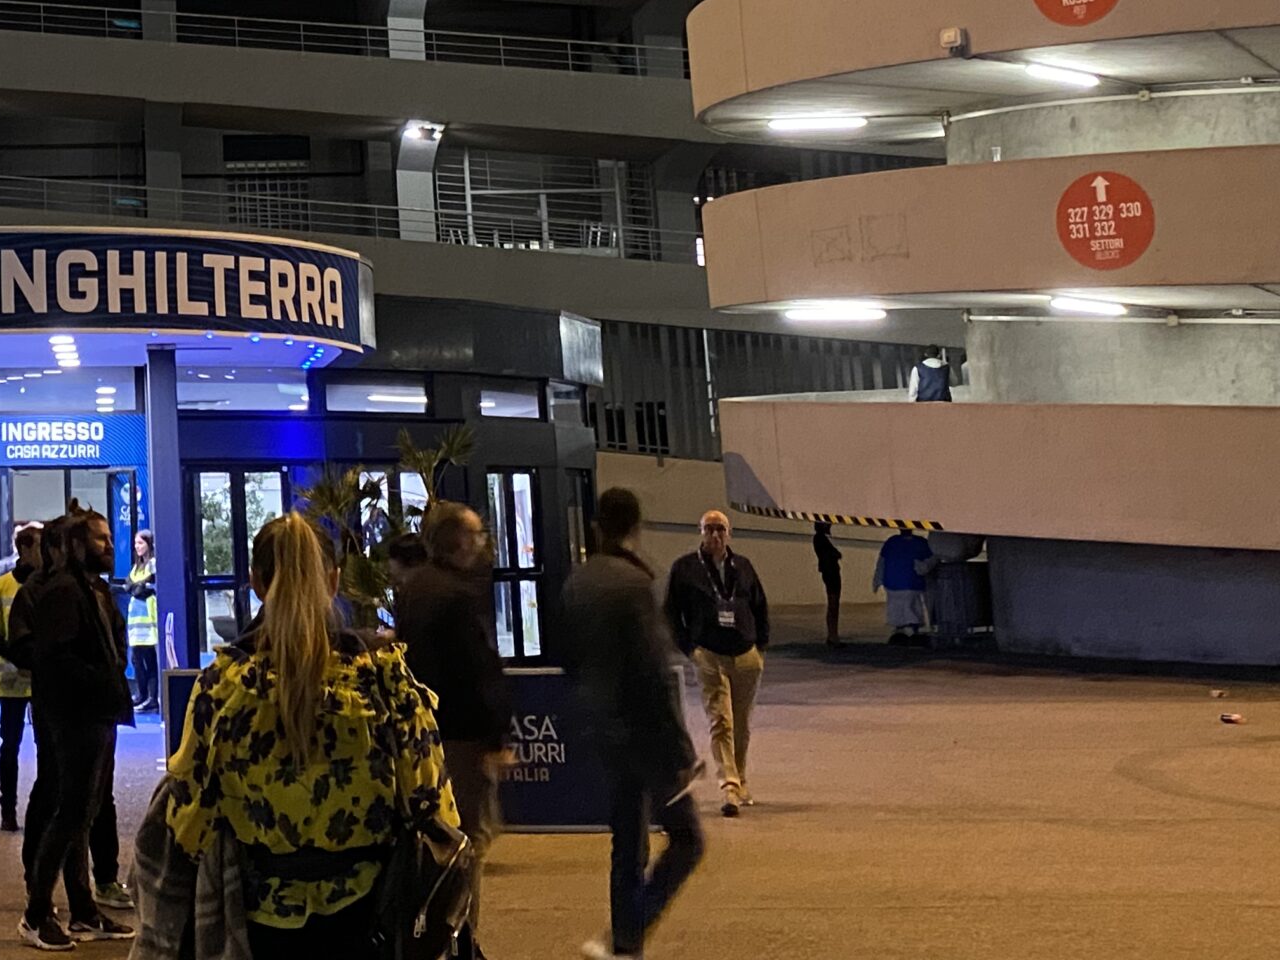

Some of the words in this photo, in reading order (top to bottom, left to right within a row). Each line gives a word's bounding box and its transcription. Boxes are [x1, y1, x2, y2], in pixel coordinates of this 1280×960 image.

[1067, 206, 1088, 223] 327
[1092, 204, 1113, 220] 329
[1119, 201, 1141, 217] 330
[1069, 223, 1089, 239] 331
[1094, 220, 1117, 236] 332
[1090, 238, 1124, 251] SETTORI
[1, 422, 104, 442] INGRESSO
[6, 444, 40, 458] CASA
[42, 444, 100, 458] AZZURRI
[510, 715, 558, 740] ASA
